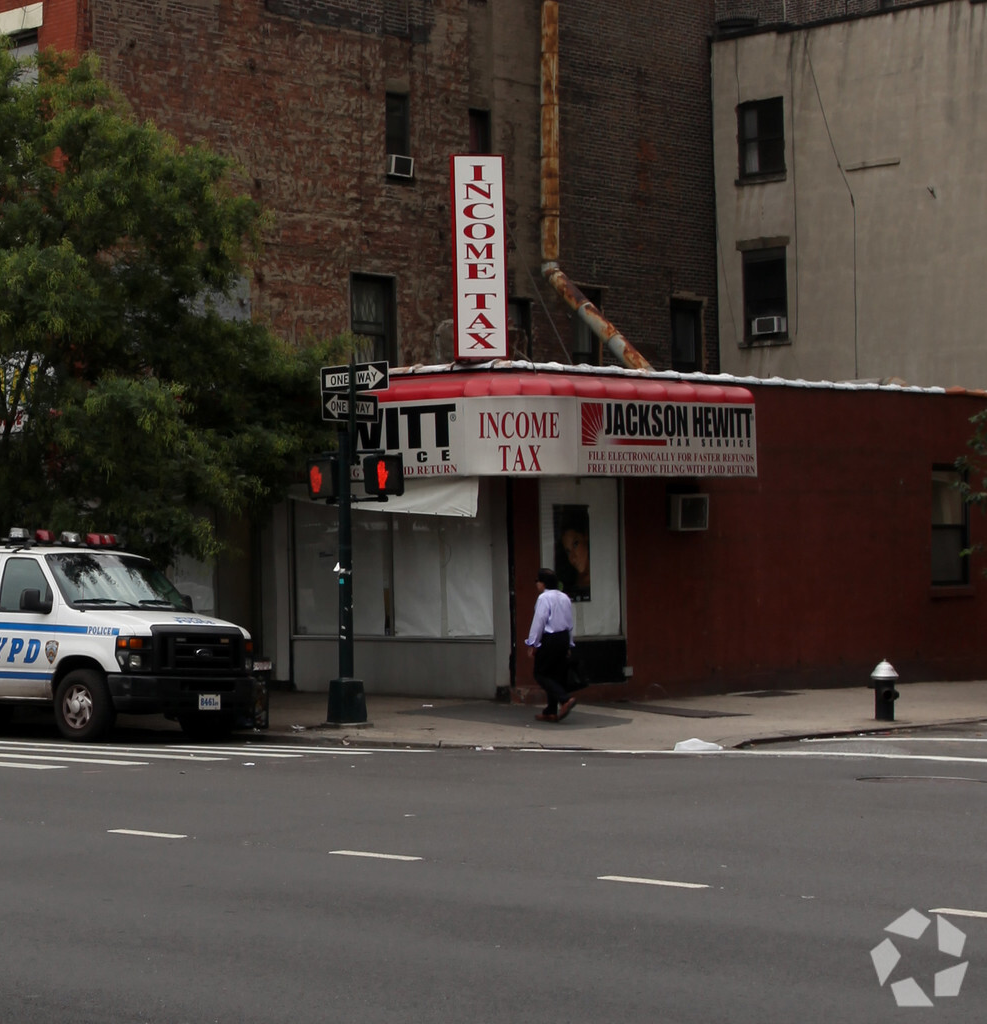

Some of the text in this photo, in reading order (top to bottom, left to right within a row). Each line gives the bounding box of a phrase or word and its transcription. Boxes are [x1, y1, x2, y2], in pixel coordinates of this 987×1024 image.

[462, 164, 498, 350] INCOME TAX
[330, 371, 378, 386] ONE WAY
[330, 400, 347, 413] ONE
[355, 403, 456, 450] WITT
[478, 411, 560, 439] INCOME
[605, 402, 753, 438] JACKSON HEWITT
[669, 438, 751, 448] TAX SERVICE
[498, 444, 542, 472] TAX
[588, 451, 754, 463] FILE ELECTRONICALLY FOR FASTER REFUNDS
[417, 464, 458, 475] RETURN
[587, 463, 756, 474] FREE ELECTRONIC FILING WITH PAID RETURN
[88, 625, 112, 636] POLICE
